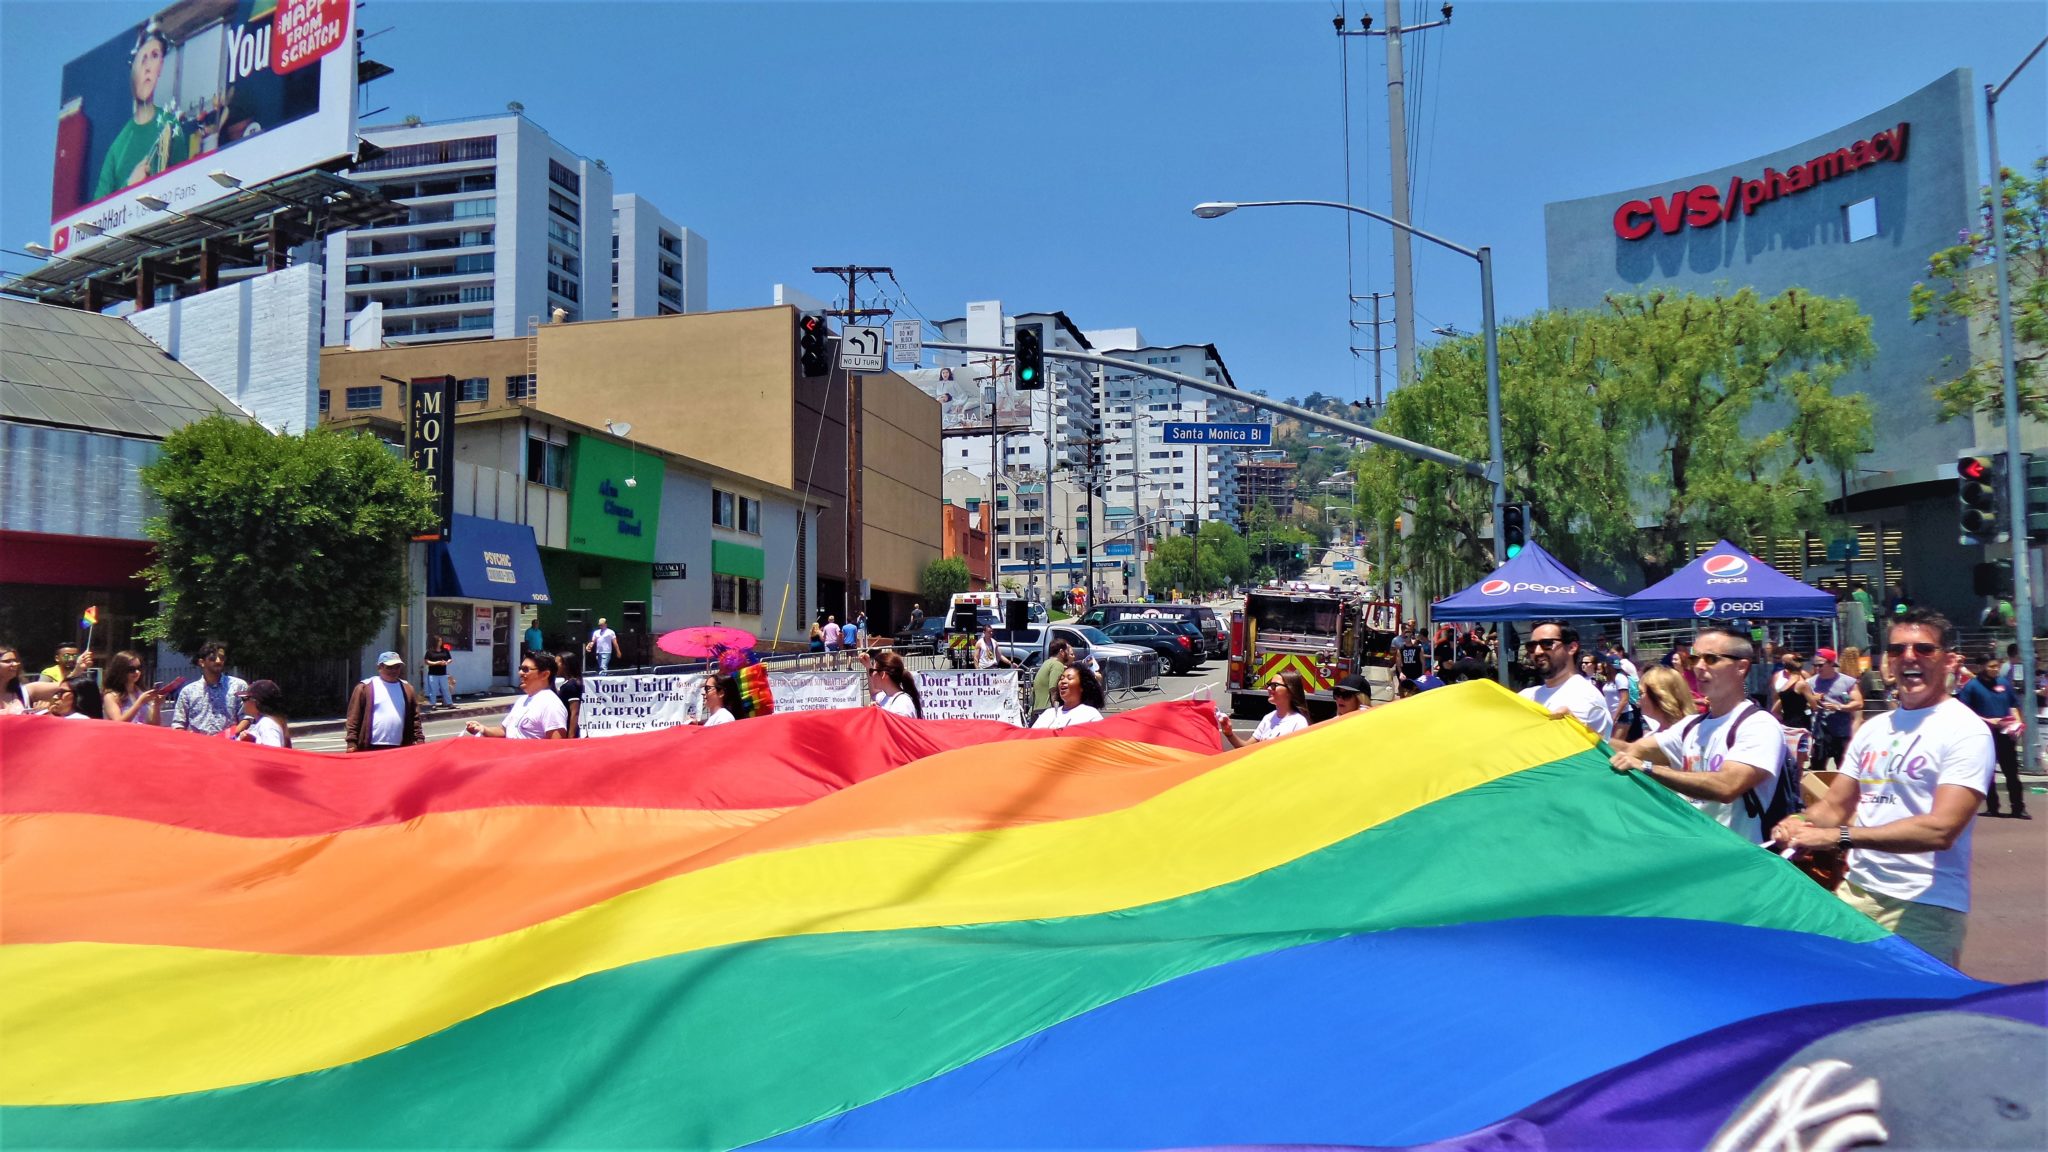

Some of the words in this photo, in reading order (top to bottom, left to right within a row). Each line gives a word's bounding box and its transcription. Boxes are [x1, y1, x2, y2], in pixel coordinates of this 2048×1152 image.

[286, 13, 322, 47] FROM
[281, 19, 339, 68] SCRATCH
[228, 24, 271, 83] You
[174, 183, 196, 202] Fans
[854, 357, 861, 366] U
[1172, 427, 1204, 440] Santa
[1208, 428, 1246, 440] Monica
[484, 551, 512, 567] PSYCHIC
[1706, 576, 1748, 585] pepsi
[1513, 582, 1578, 595] pepsi
[531, 593, 549, 601] 1005
[1720, 600, 1764, 613] pepsi
[1402, 649, 1416, 657] GAY
[1319, 668, 1332, 678] 9
[920, 674, 951, 687] Your
[593, 680, 628, 694] Your
[936, 688, 949, 697] On
[952, 688, 974, 696] Your
[977, 687, 1001, 696] Pride
[612, 694, 625, 703] On
[630, 694, 653, 703] Your
[658, 692, 684, 702] Pride
[921, 699, 973, 710] LGBTQI
[591, 706, 652, 718] LGBTQI
[942, 711, 970, 720] Clergy
[972, 711, 1001, 720] Group
[616, 720, 647, 730] Clergy
